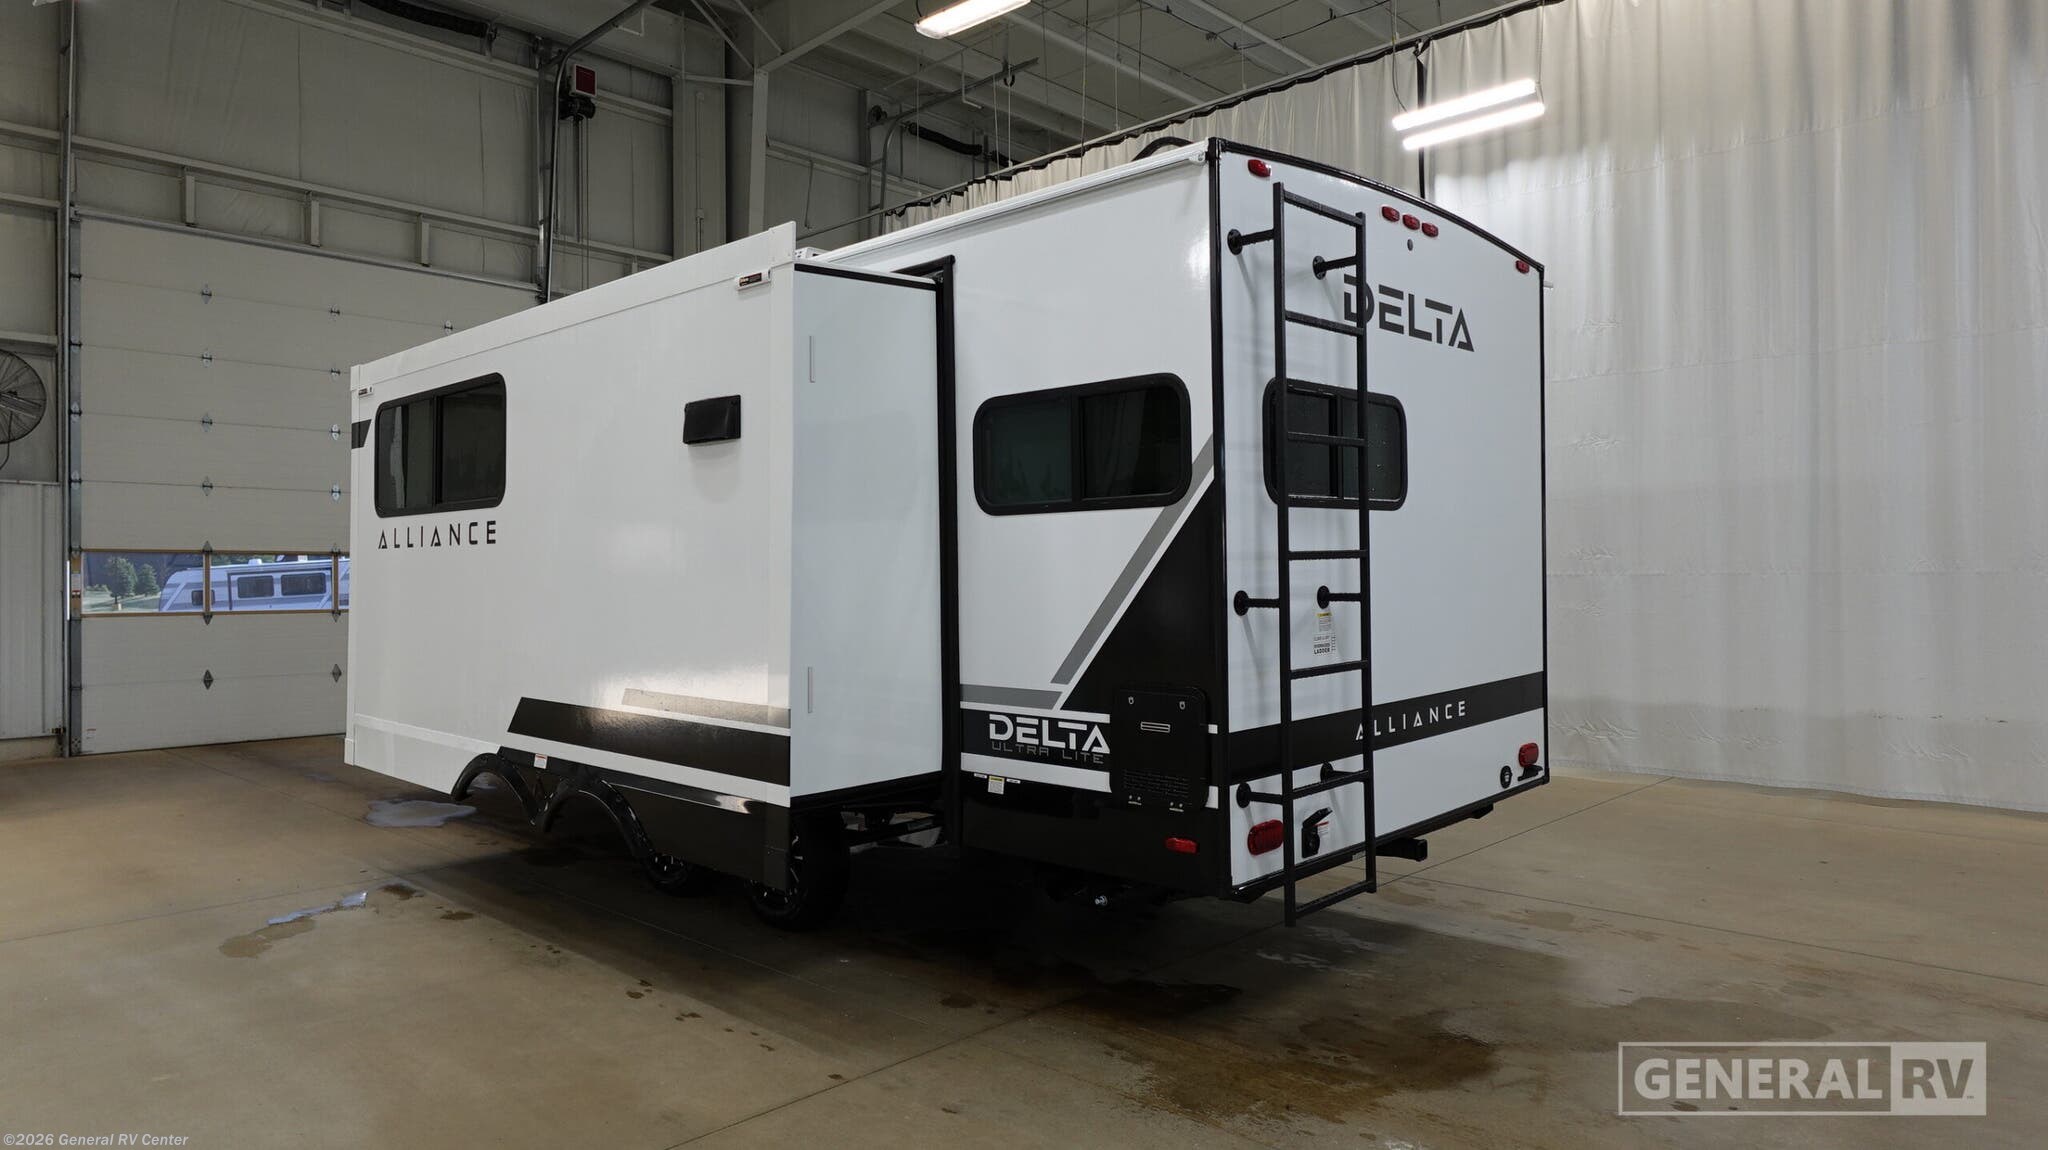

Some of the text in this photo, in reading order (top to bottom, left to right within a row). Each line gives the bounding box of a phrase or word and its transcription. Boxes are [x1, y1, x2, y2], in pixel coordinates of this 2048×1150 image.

[1344, 273, 1475, 352] DELTA
[378, 520, 496, 549] ALLIANCE
[989, 713, 1111, 754] DELTA
[1355, 700, 1466, 741] ALLIANCE
[991, 741, 1104, 764] ULTRA LITE
